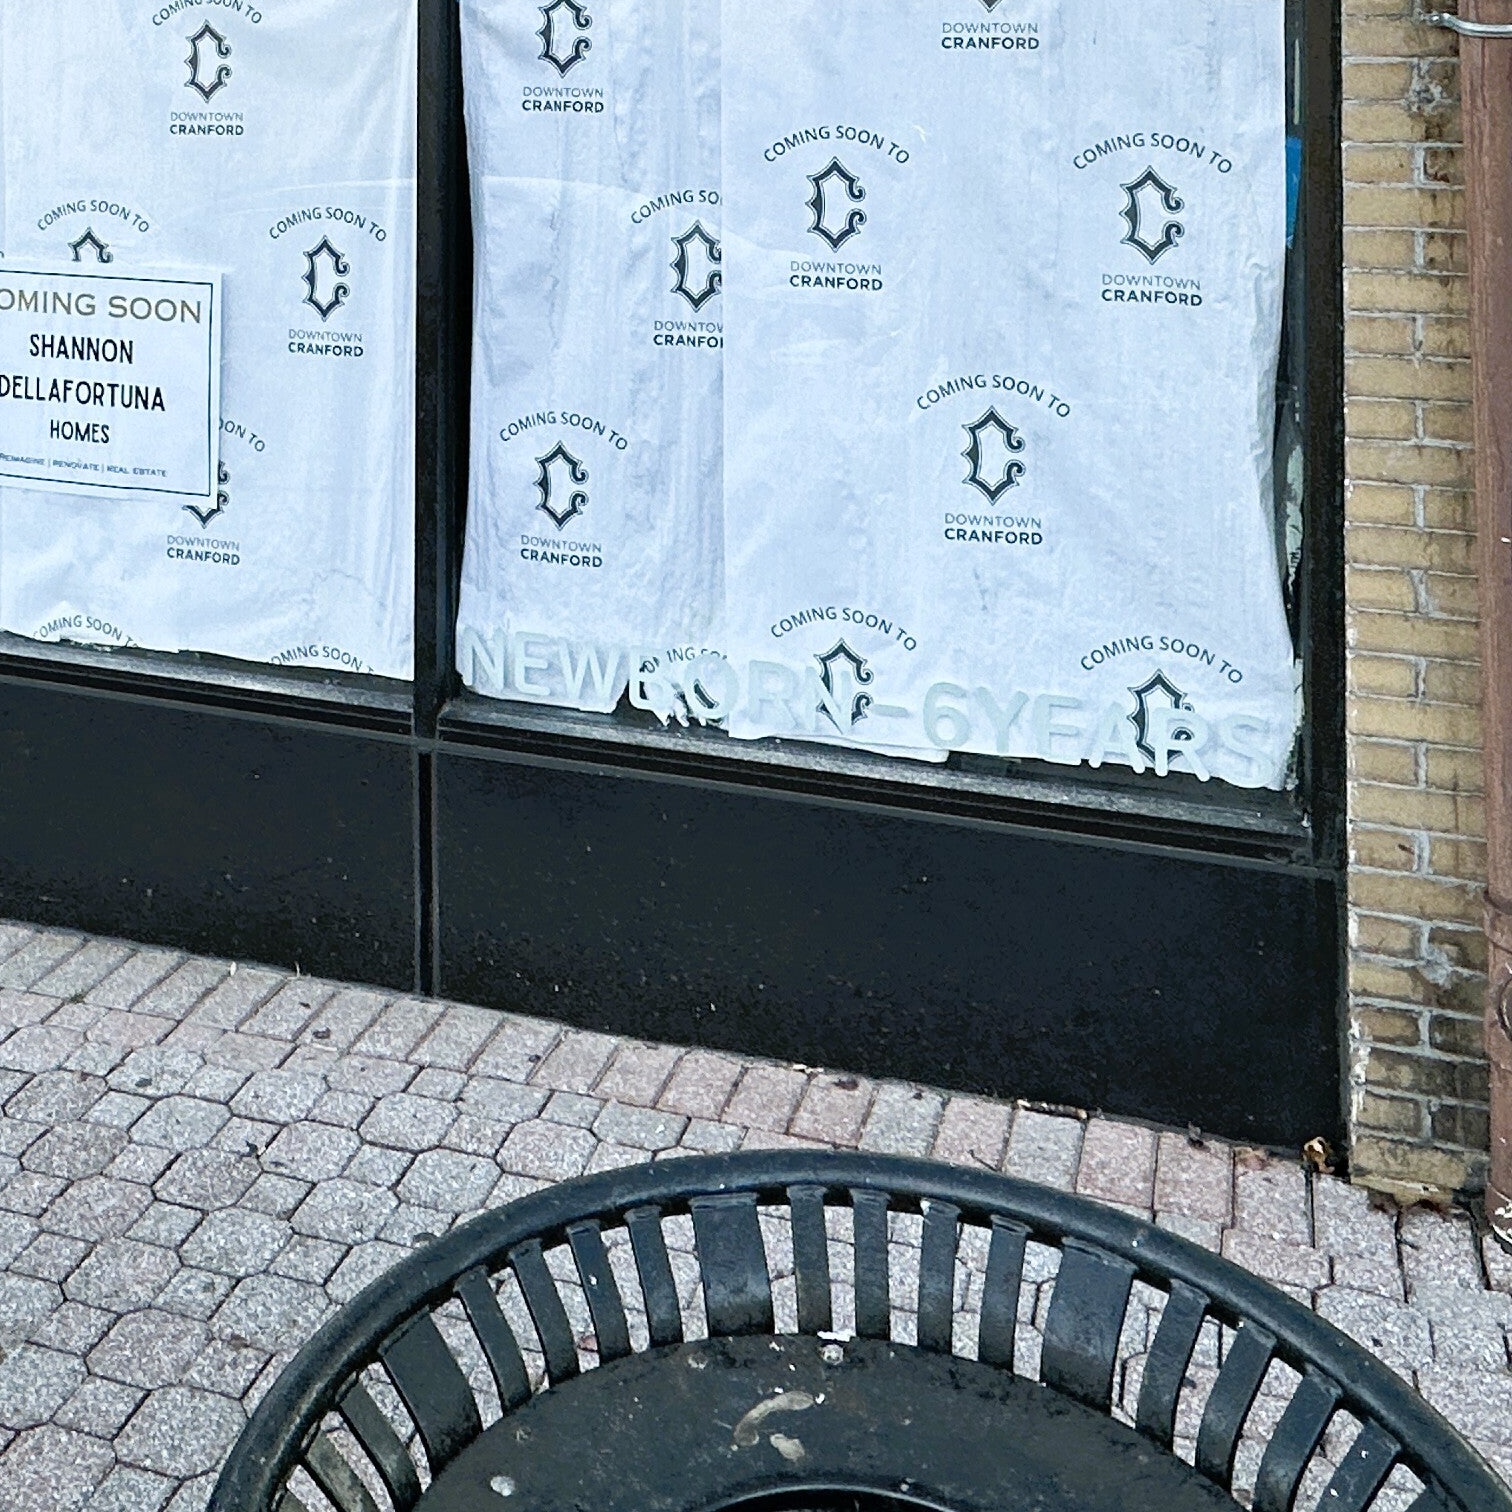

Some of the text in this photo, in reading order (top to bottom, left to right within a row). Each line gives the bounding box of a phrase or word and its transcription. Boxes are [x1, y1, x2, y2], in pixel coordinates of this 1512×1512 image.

[245, 5, 263, 25] TO
[941, 22, 1039, 35] DOWNTOWN
[941, 36, 1040, 50] CRANFORD
[523, 86, 604, 99] DOWNTOWN
[521, 99, 604, 114] CRANFORD
[170, 112, 244, 122] DOWNTOWN
[170, 124, 244, 136] CRANFORD
[763, 125, 910, 165] COMING SOON TO
[1073, 132, 1233, 174] COMING SOON TO
[37, 200, 150, 234] COMING SOON TO
[630, 190, 694, 225] COMING
[269, 206, 387, 243] COMING SOON TO
[790, 261, 882, 275] DOWNTOWN
[789, 275, 883, 292] CRANFORD
[1101, 274, 1201, 290] DOWNTOWN
[1101, 289, 1203, 307] CRANFORD
[108, 295, 201, 323] SOON
[288, 329, 363, 343] DOWNTOWN
[29, 334, 134, 364] SHANNON
[288, 341, 364, 358] CRANFORD
[916, 375, 1071, 418] COMING SOON TO
[50, 419, 110, 444] HOMES
[499, 411, 629, 452] COMING SOON TO
[248, 433, 266, 453] TO
[944, 513, 1042, 529] DOWNTOWN
[167, 534, 240, 552] DOWNTOWN
[521, 535, 602, 553] DOWNTOWN
[944, 528, 1043, 546] CRANFORD
[166, 547, 241, 566] CRANFORD
[520, 548, 603, 569] CRANFORD
[86, 616, 122, 640] SOON
[770, 606, 917, 651] COMING SOON TO
[270, 644, 363, 672] OMING SOON
[1080, 636, 1243, 685] COMING SOON TO
